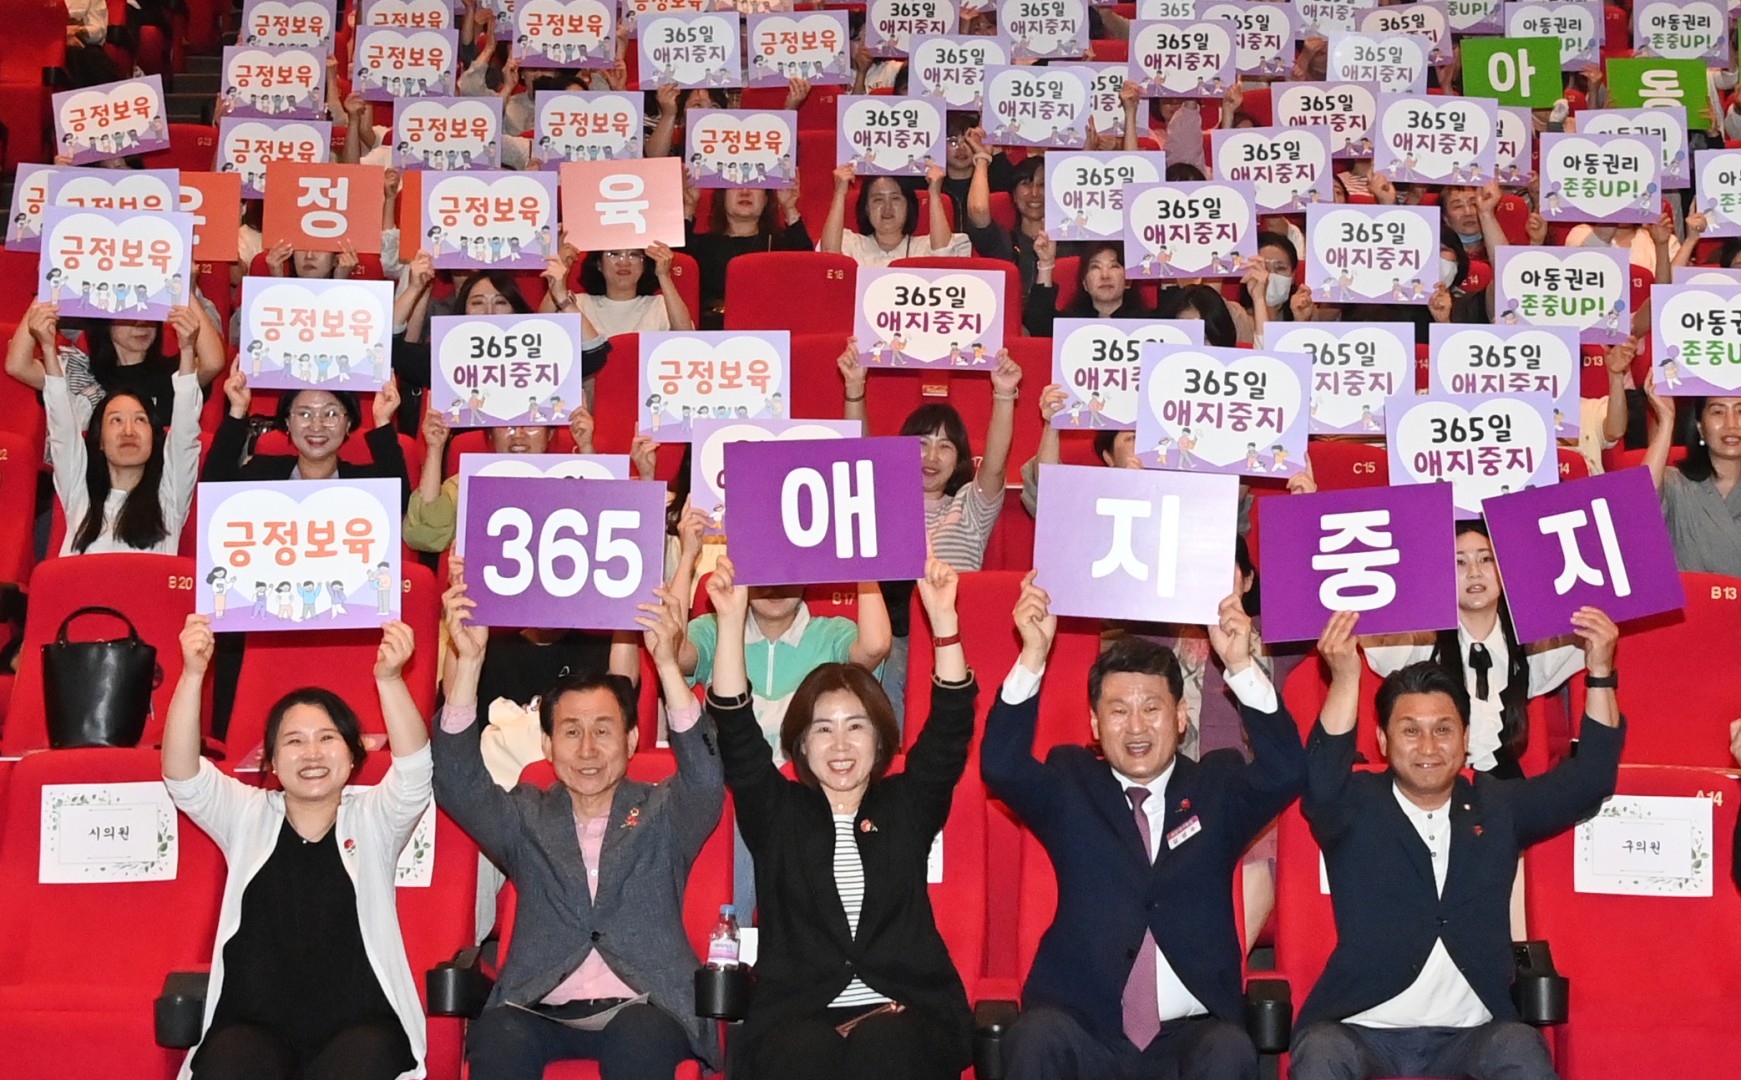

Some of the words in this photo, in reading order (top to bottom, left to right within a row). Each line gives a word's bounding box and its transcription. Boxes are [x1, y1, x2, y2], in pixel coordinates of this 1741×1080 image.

[890, 3, 935, 17] 365일
[1020, 1, 1065, 17] 365일
[1160, 3, 1195, 17] 365
[255, 14, 324, 37] 긍정보육
[526, 13, 603, 37] 긍정보육
[879, 19, 946, 34] 애지중지
[1011, 18, 1076, 36] 애지중지
[1380, 14, 1425, 32] 365일
[1522, 17, 1582, 34] 아동권리
[1651, 14, 1710, 31] 아동권리
[664, 26, 714, 43] 365일
[760, 29, 837, 55] 긍정보육
[1156, 33, 1209, 50] 365일
[1651, 33, 1710, 50] 존중UP!
[367, 47, 444, 71] 긍정보육
[653, 45, 726, 63] 애지중지
[935, 48, 985, 65] 365일
[1144, 53, 1220, 71] 애지중지
[1354, 46, 1403, 64] 365일
[235, 65, 312, 88] 긍정보육
[1342, 65, 1413, 83] 애지중지
[1488, 48, 1536, 97] 아
[1011, 80, 1063, 98] 365일
[69, 96, 152, 132] 긍정보육
[998, 101, 1075, 120] 애지중지
[1300, 94, 1354, 112] 365일
[406, 116, 489, 142] 긍정보육
[548, 111, 630, 137] 긍정보육
[866, 110, 919, 128] 365일
[1408, 111, 1466, 132] 365일
[232, 138, 316, 164] 긍정보육
[700, 129, 783, 155] 긍정보육
[854, 130, 931, 149] 애지중지
[1243, 141, 1301, 161] 365일
[1393, 132, 1479, 155] 애지중지
[1076, 166, 1135, 185] 365일
[1231, 163, 1316, 184] 애지중지
[1563, 154, 1639, 174] 아동권리
[1563, 178, 1639, 198] 존중UP!
[297, 176, 350, 239] 정
[439, 195, 541, 227] 긍정보육
[594, 173, 650, 235] 육
[1157, 198, 1222, 219] 365일
[1144, 222, 1239, 245] 애지중지
[1341, 222, 1406, 244] 365일
[60, 236, 173, 274] 긍정보육
[1326, 246, 1421, 270] 애지중지
[1520, 268, 1605, 291] 아동권리
[894, 285, 966, 308] 365일
[1521, 294, 1606, 318] 존중UP!
[260, 306, 374, 344] 긍정보육
[876, 311, 982, 335] 애지중지
[470, 333, 543, 359] 365일
[1468, 344, 1541, 369] 365일
[453, 362, 560, 389] 애지중지
[658, 359, 772, 395] 긍정보육
[1184, 368, 1267, 400] 365일
[1163, 400, 1284, 433] 애지중지
[1430, 413, 1512, 443] 365일
[1414, 446, 1534, 477] 애지중지
[781, 459, 879, 560] 애
[223, 517, 376, 568] 긍정보육
[482, 506, 643, 598] 365
[1091, 494, 1181, 598] 지
[1537, 497, 1632, 599] 지
[1311, 509, 1400, 612] 중
[88, 825, 130, 842] 시의원
[1621, 839, 1662, 856] 구의원
